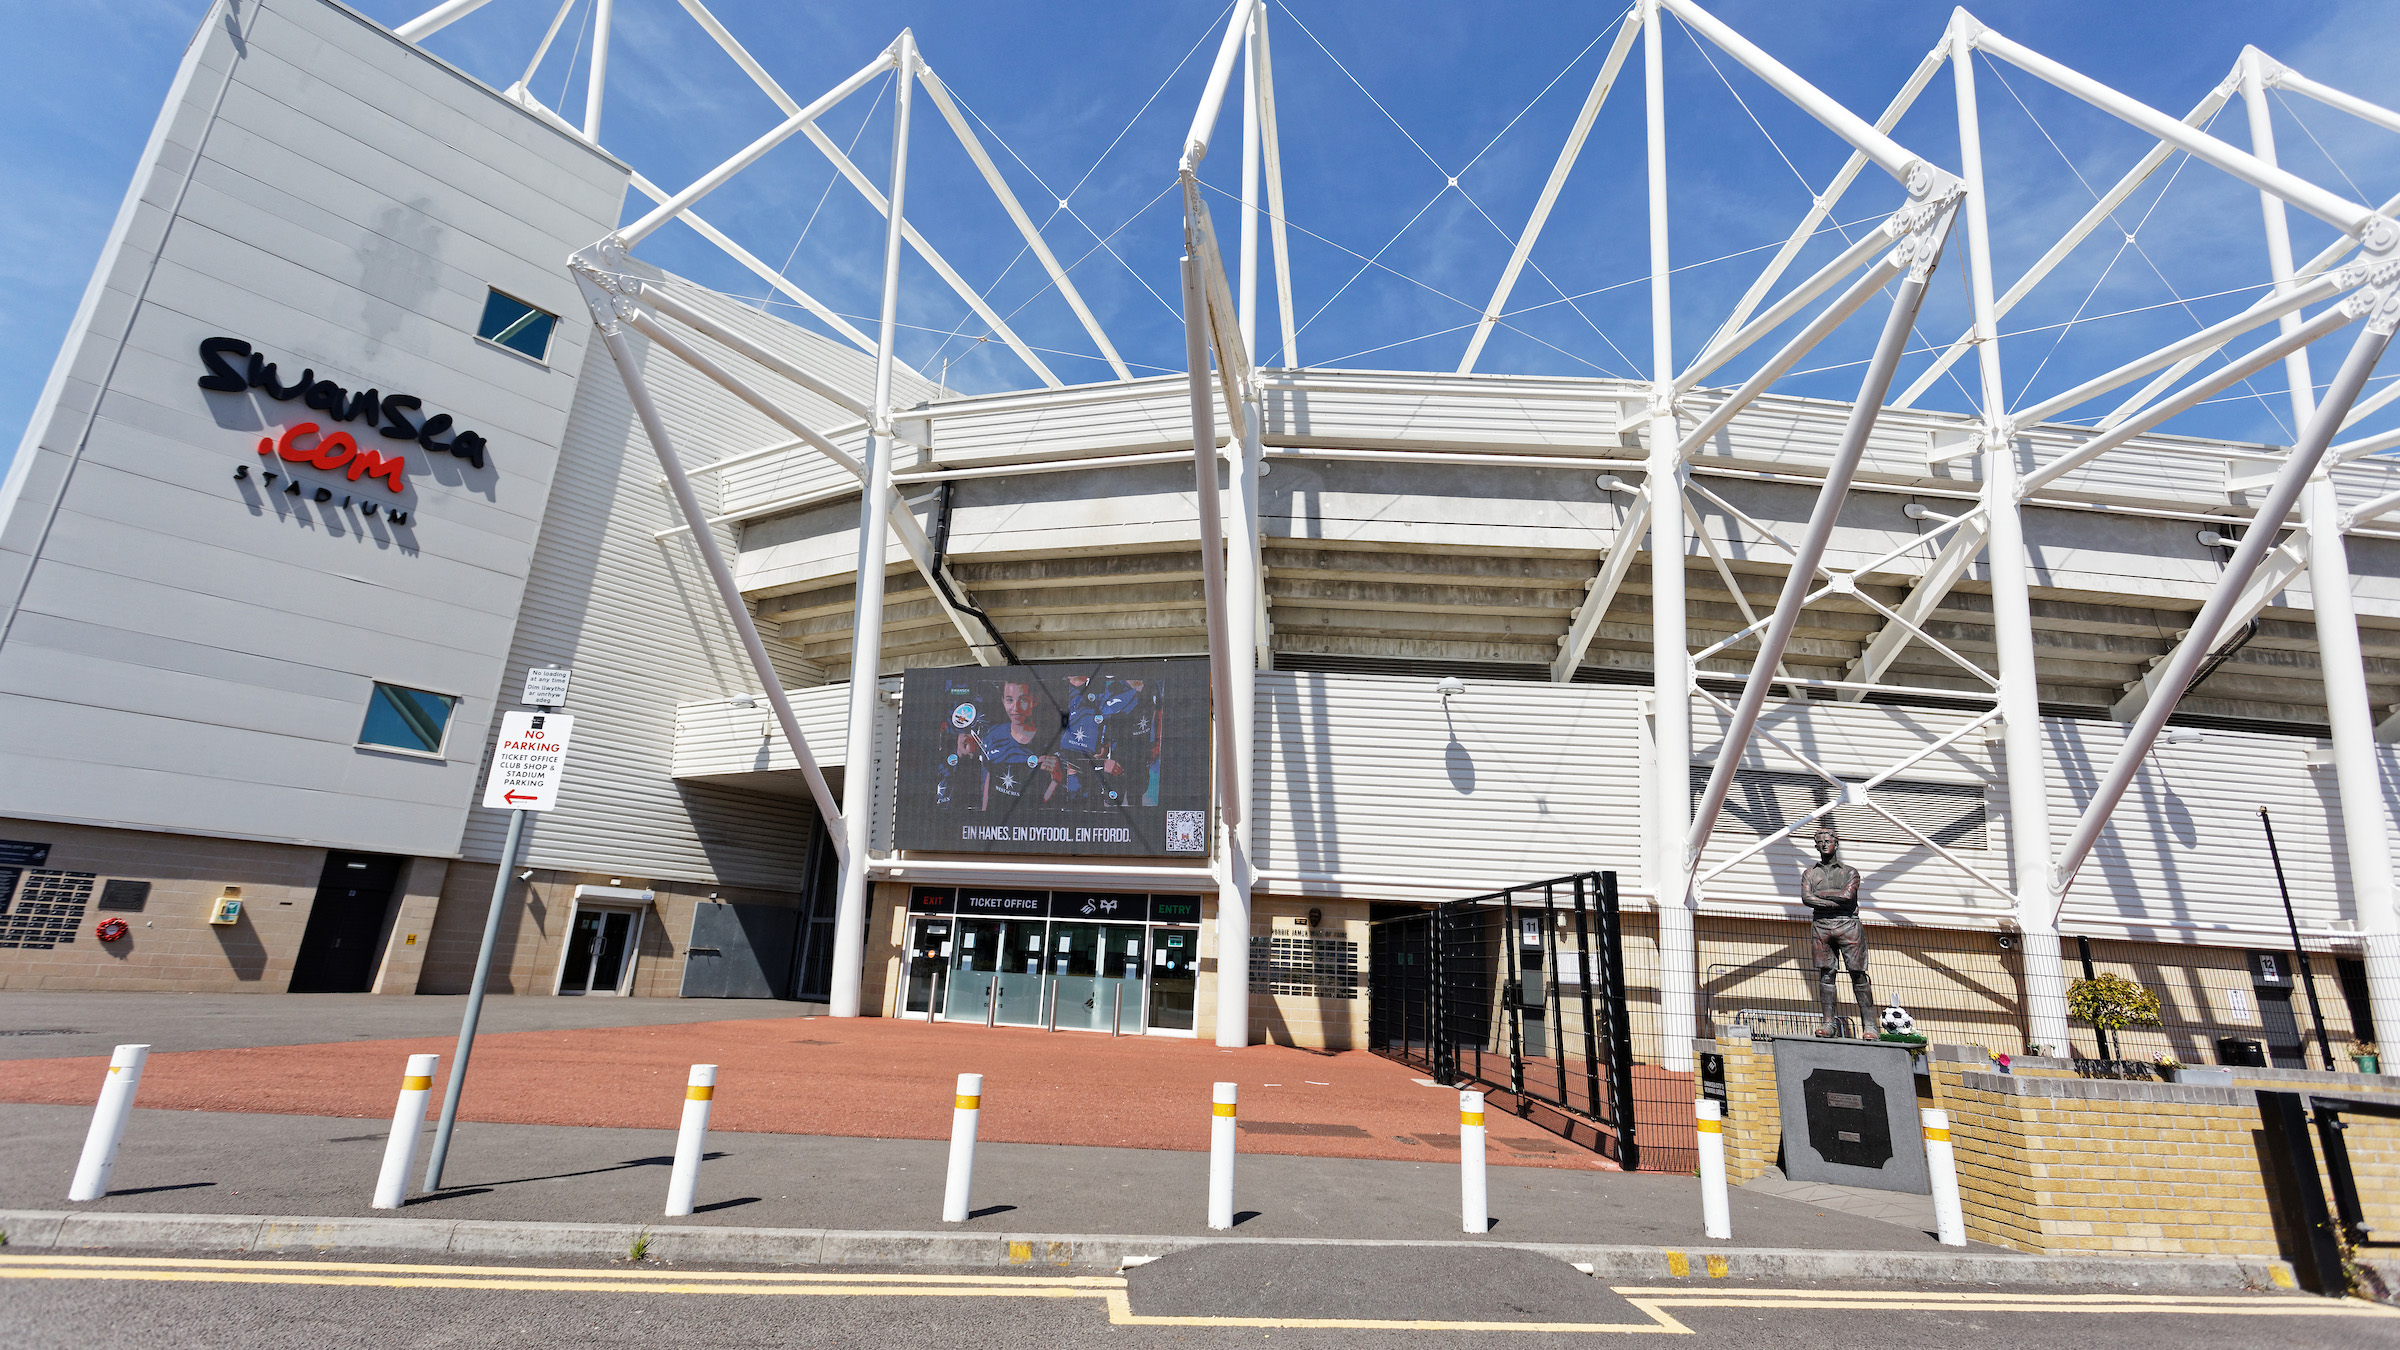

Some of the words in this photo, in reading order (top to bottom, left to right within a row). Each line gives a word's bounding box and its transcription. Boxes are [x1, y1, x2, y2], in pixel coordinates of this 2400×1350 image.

[233, 465, 408, 525] STADIUM
[525, 730, 545, 740] NO
[503, 740, 560, 752] PARKING
[501, 753, 528, 761] TICKET
[530, 755, 558, 763] OFFICE
[506, 770, 545, 779] STADIUM
[504, 779, 544, 787] PARKING
[962, 825, 978, 840] EIN
[978, 826, 1011, 841] HANES.
[1012, 826, 1028, 841] EIN
[1029, 826, 1074, 842] DYFODOL.
[1075, 827, 1091, 842] EIN
[1092, 828, 1132, 843] FFORDD.
[923, 896, 943, 905] EXIT
[969, 897, 1002, 908] TICKET
[1004, 898, 1038, 909] OFFICE
[1158, 904, 1192, 914] ENTRY
[1526, 921, 1536, 932] 11
[2262, 959, 2274, 969] 12
